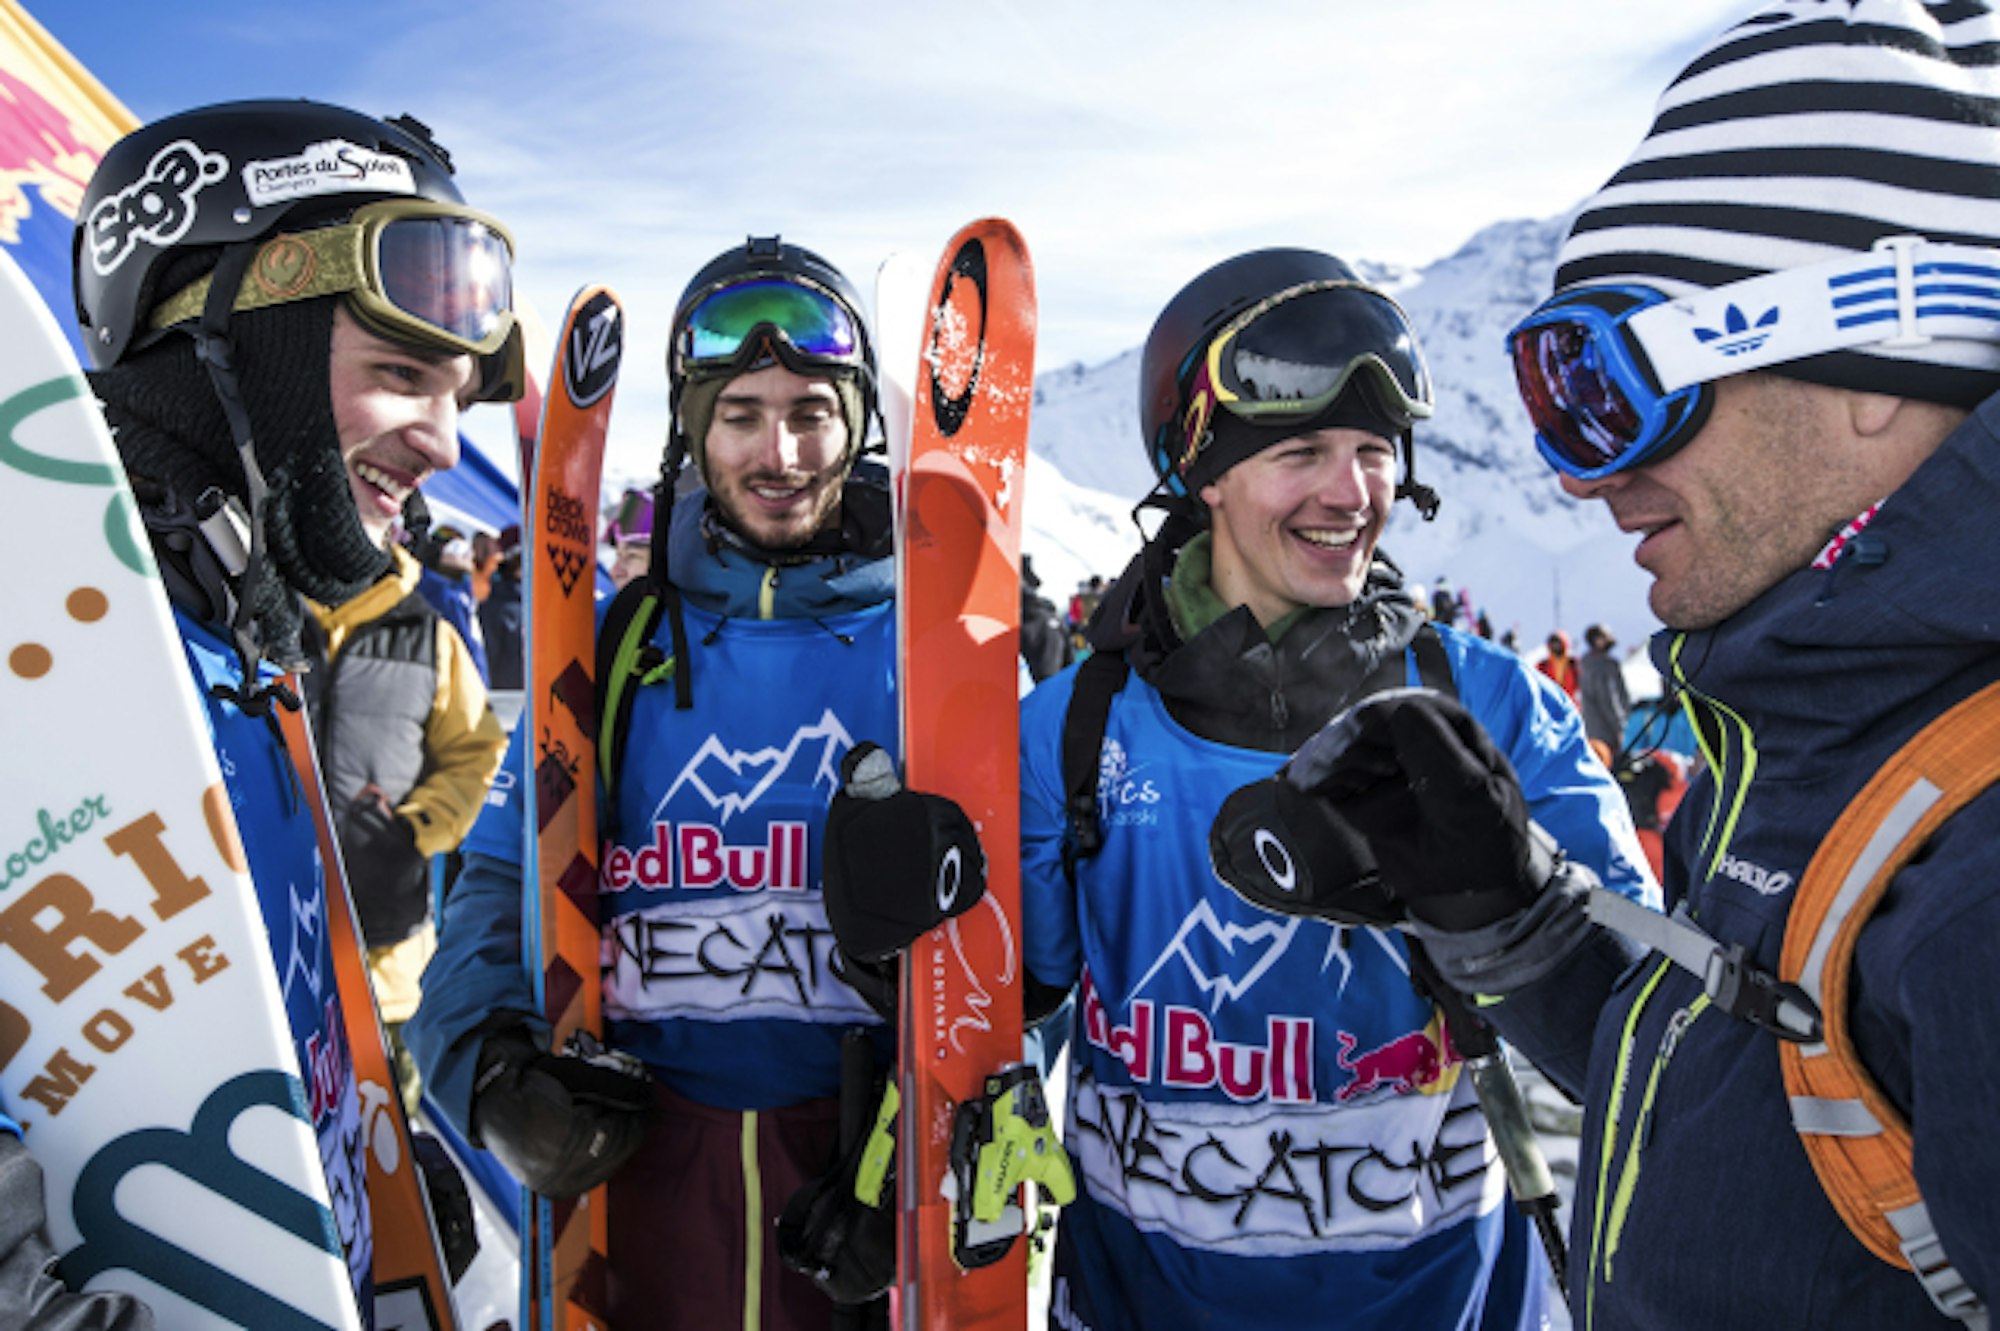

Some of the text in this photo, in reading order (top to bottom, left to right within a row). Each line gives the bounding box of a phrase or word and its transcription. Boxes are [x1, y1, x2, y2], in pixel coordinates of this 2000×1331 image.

[0, 794, 112, 892] ocker
[601, 821, 808, 893] ed Bull
[19, 934, 232, 1118] MOVE
[1162, 1004, 1315, 1105] Bull
